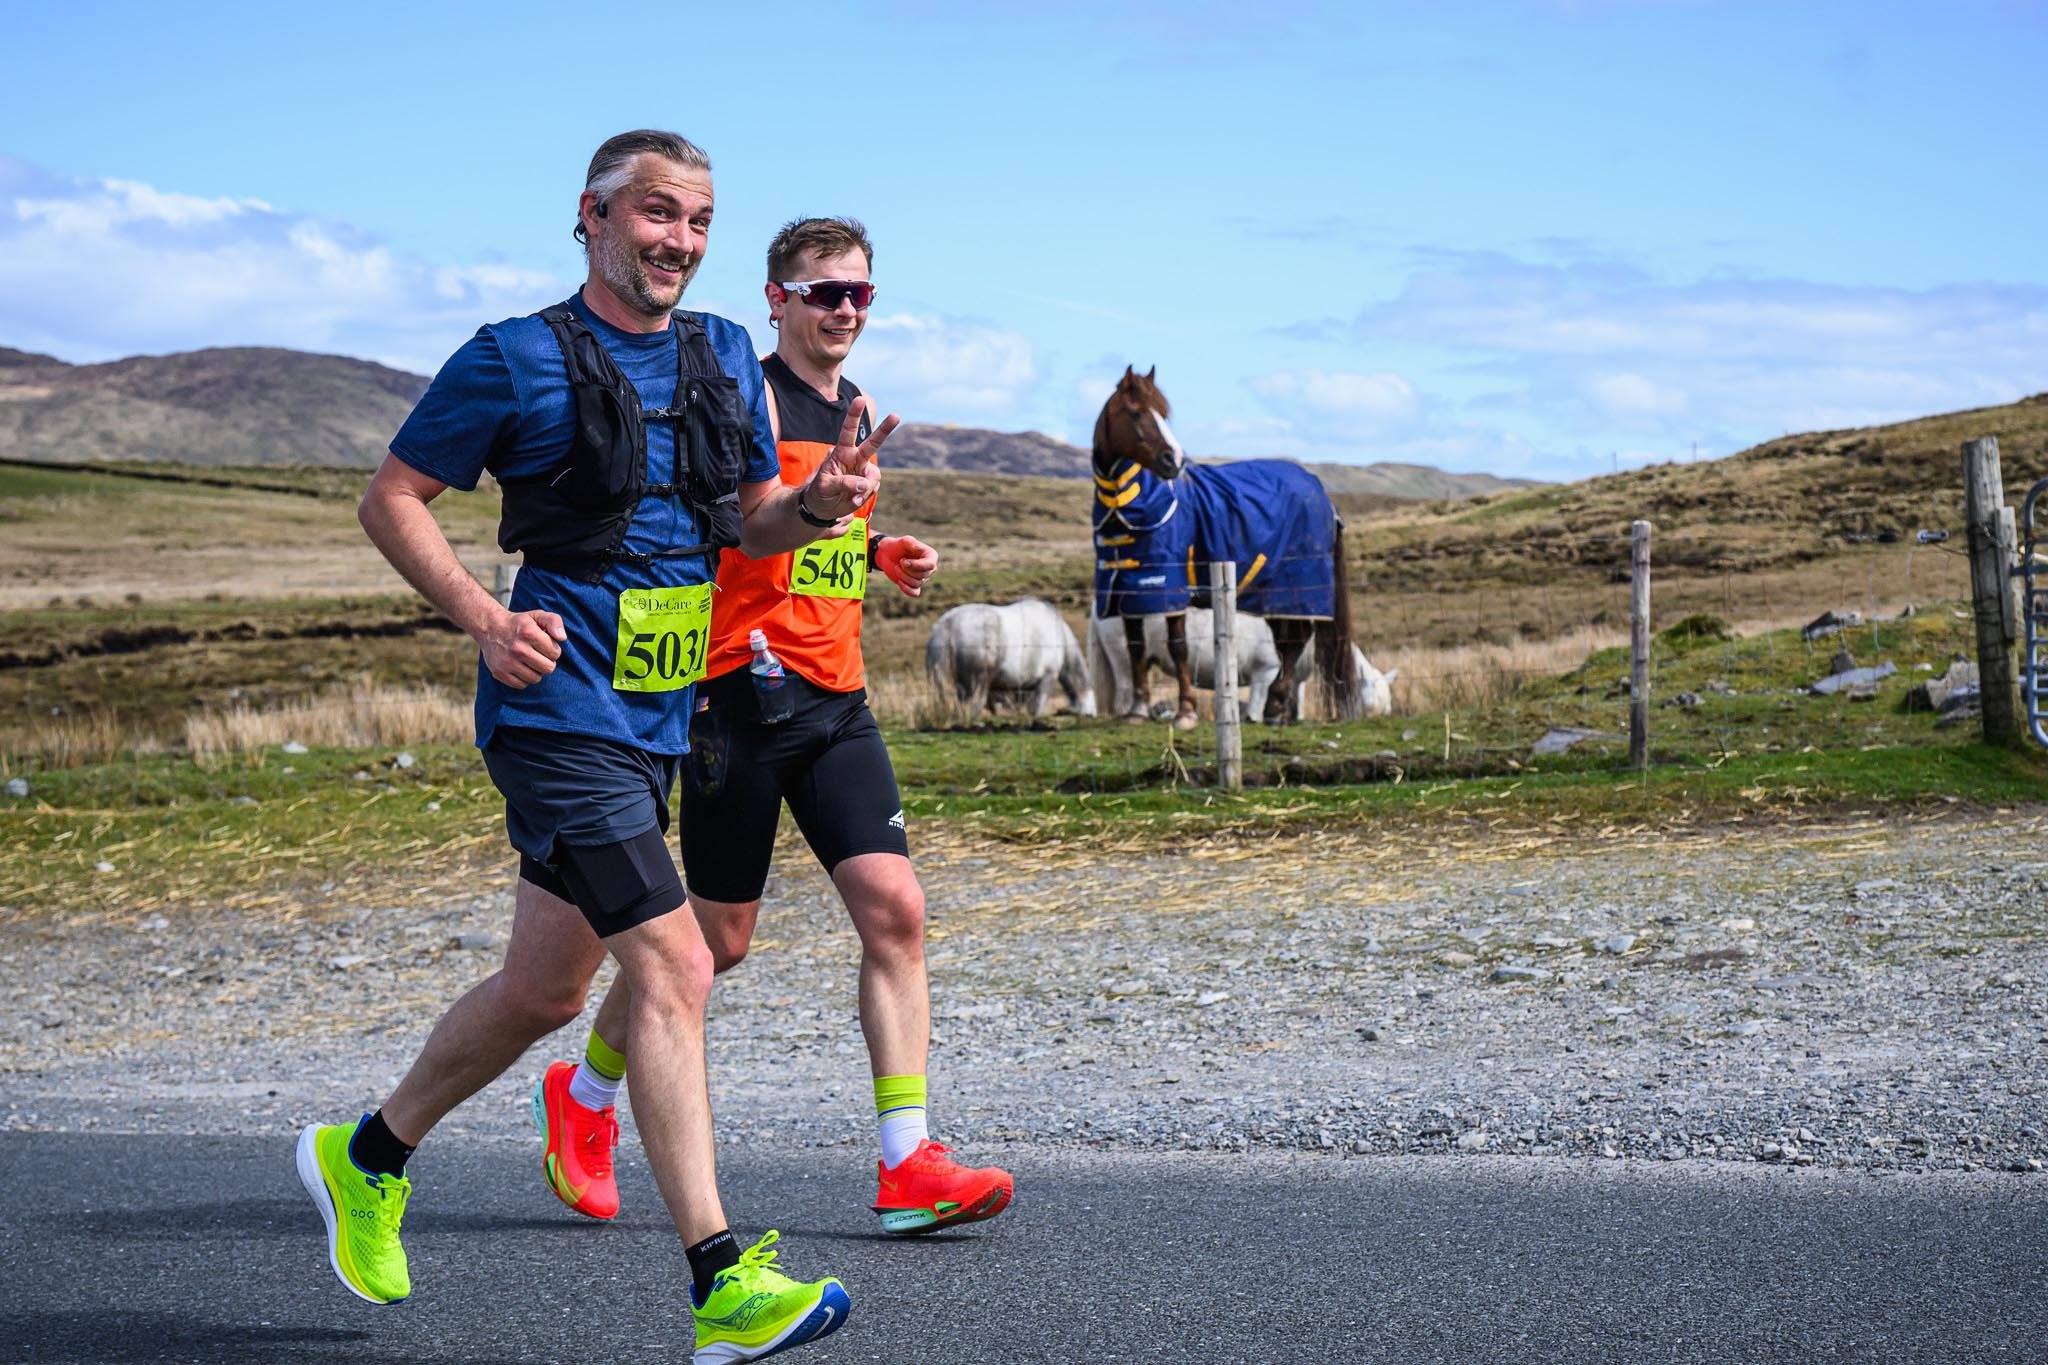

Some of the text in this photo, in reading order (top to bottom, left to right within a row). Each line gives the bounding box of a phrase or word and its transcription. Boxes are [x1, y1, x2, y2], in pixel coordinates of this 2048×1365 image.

[797, 547, 866, 590] 5487
[648, 597, 692, 611] DeCare
[623, 624, 708, 680] 5031
[699, 1233, 732, 1253] KIPRUN
